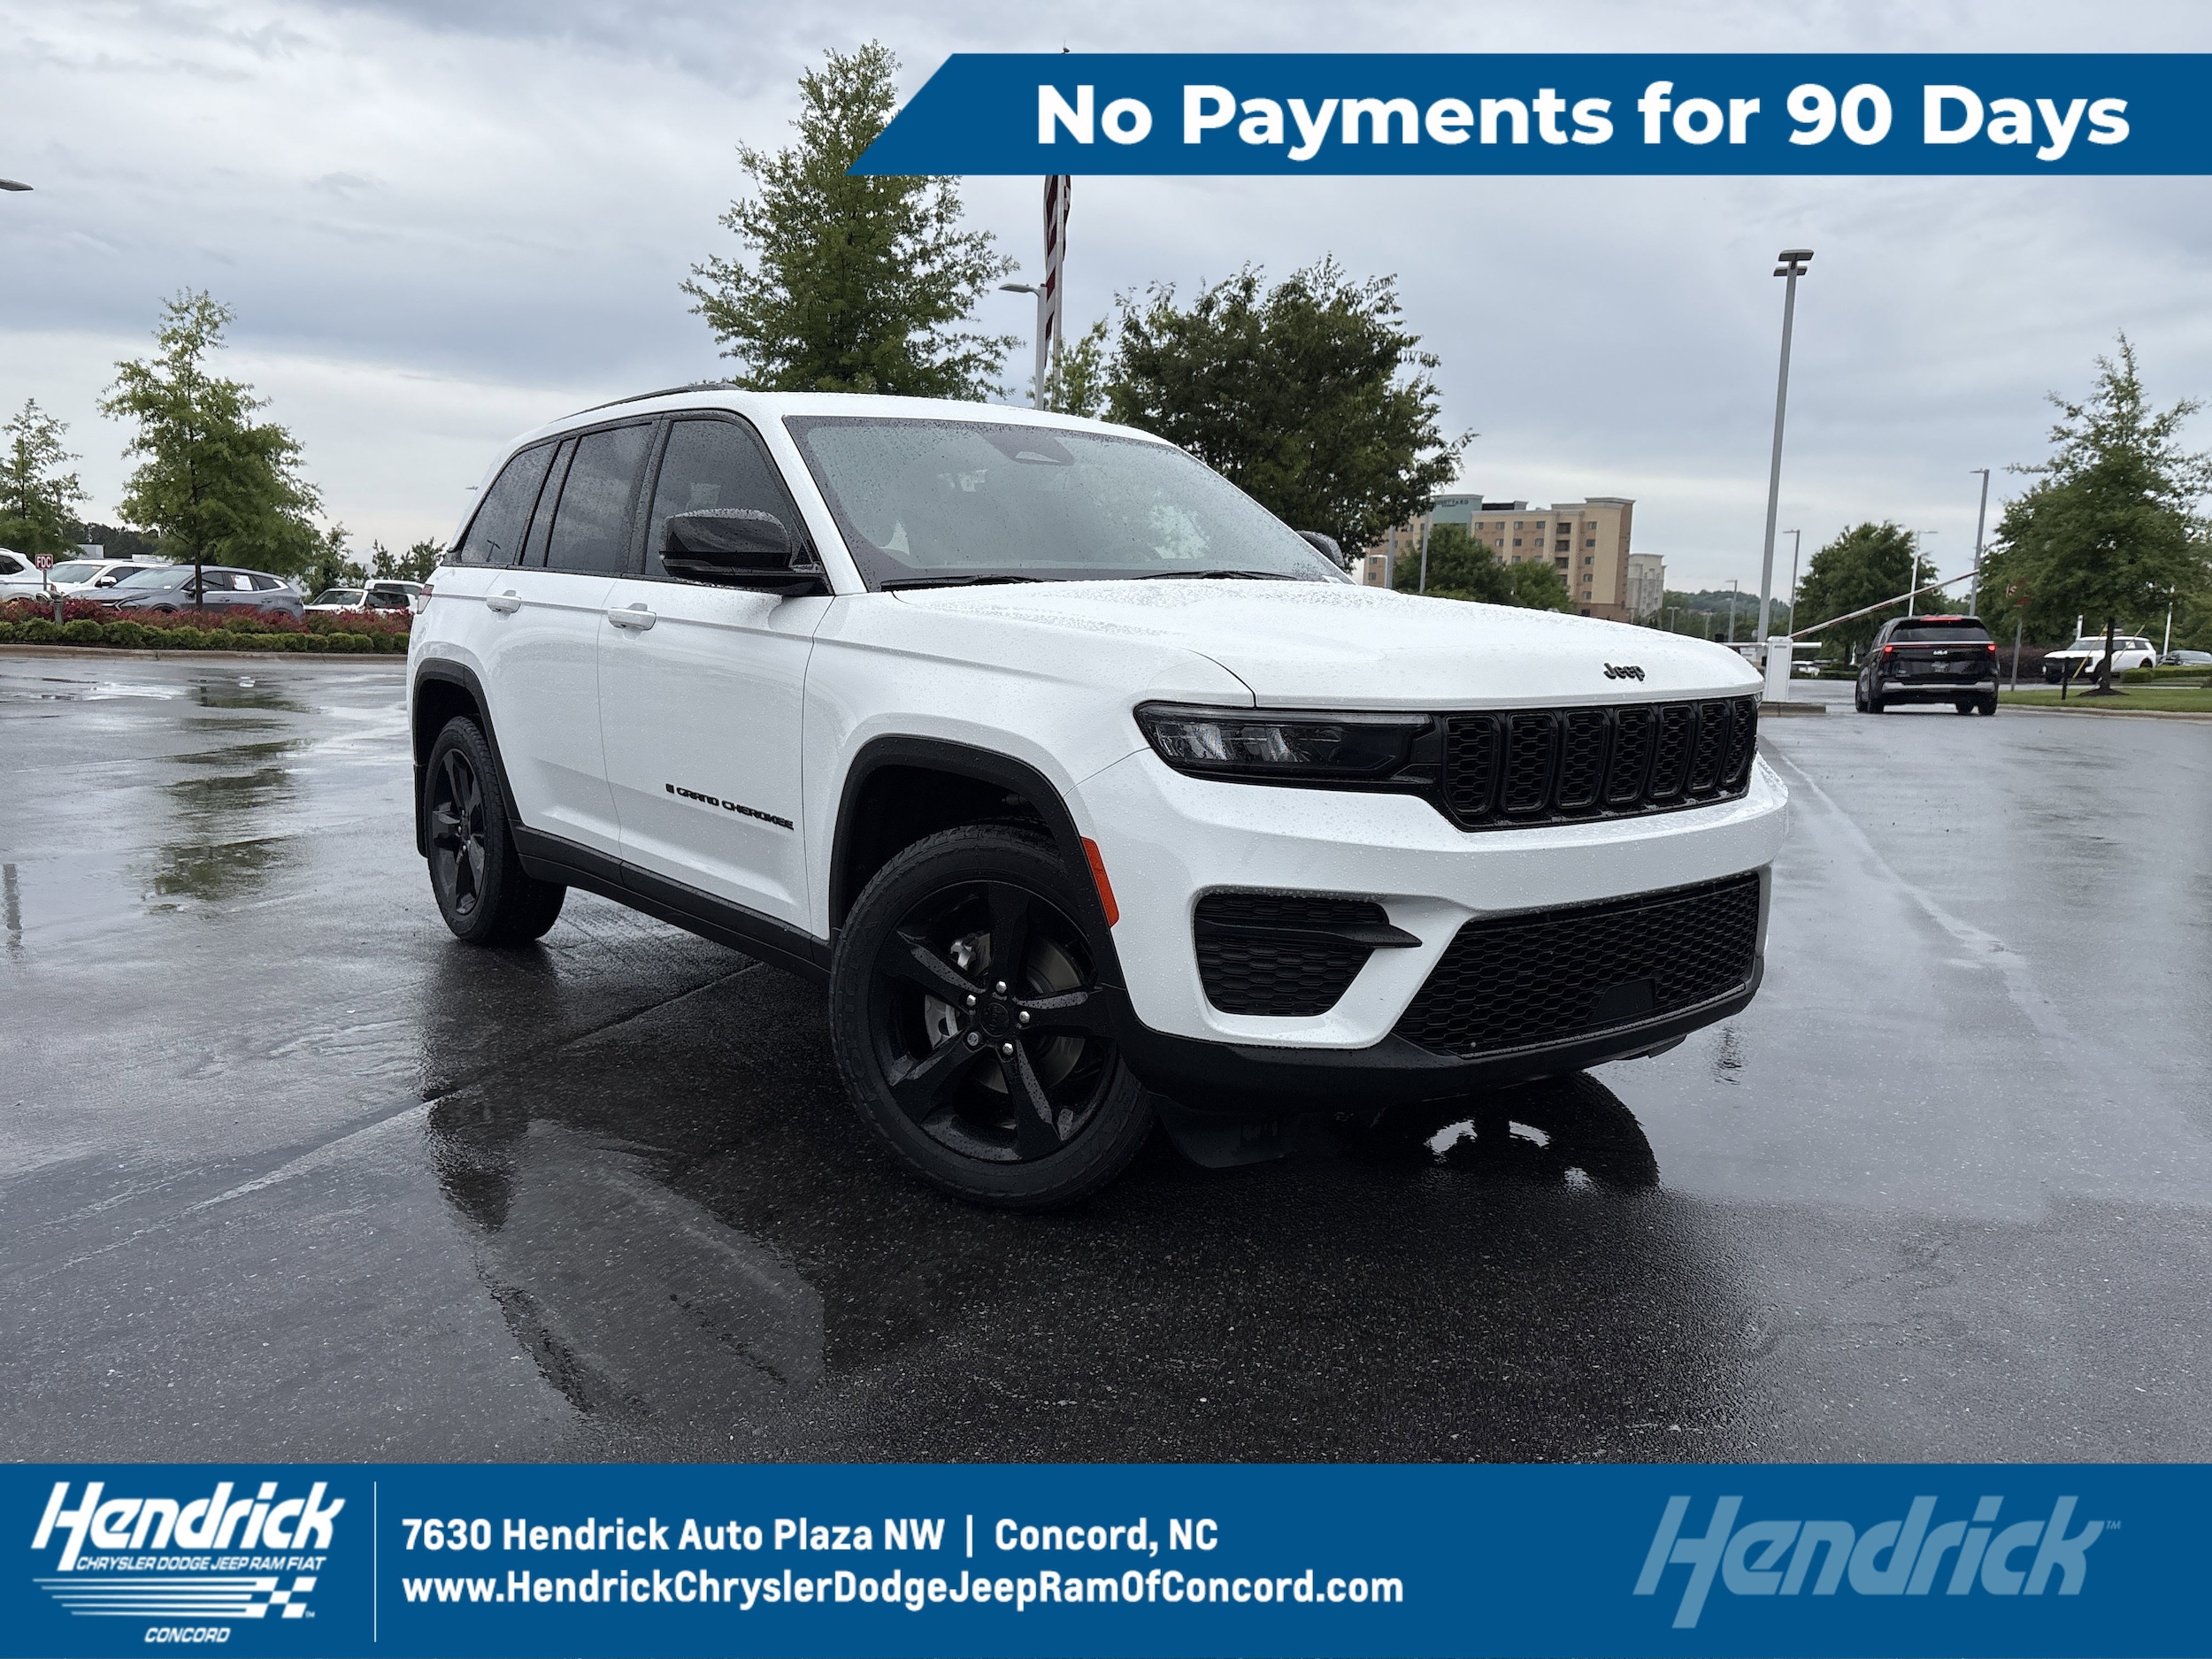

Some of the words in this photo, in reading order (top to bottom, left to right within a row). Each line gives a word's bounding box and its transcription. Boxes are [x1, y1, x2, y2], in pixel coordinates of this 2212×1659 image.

[36, 556, 51, 568] FDC
[1603, 663, 1645, 681] Jeep
[677, 787, 719, 806] GRAND
[722, 801, 794, 830] CHEROKEE
